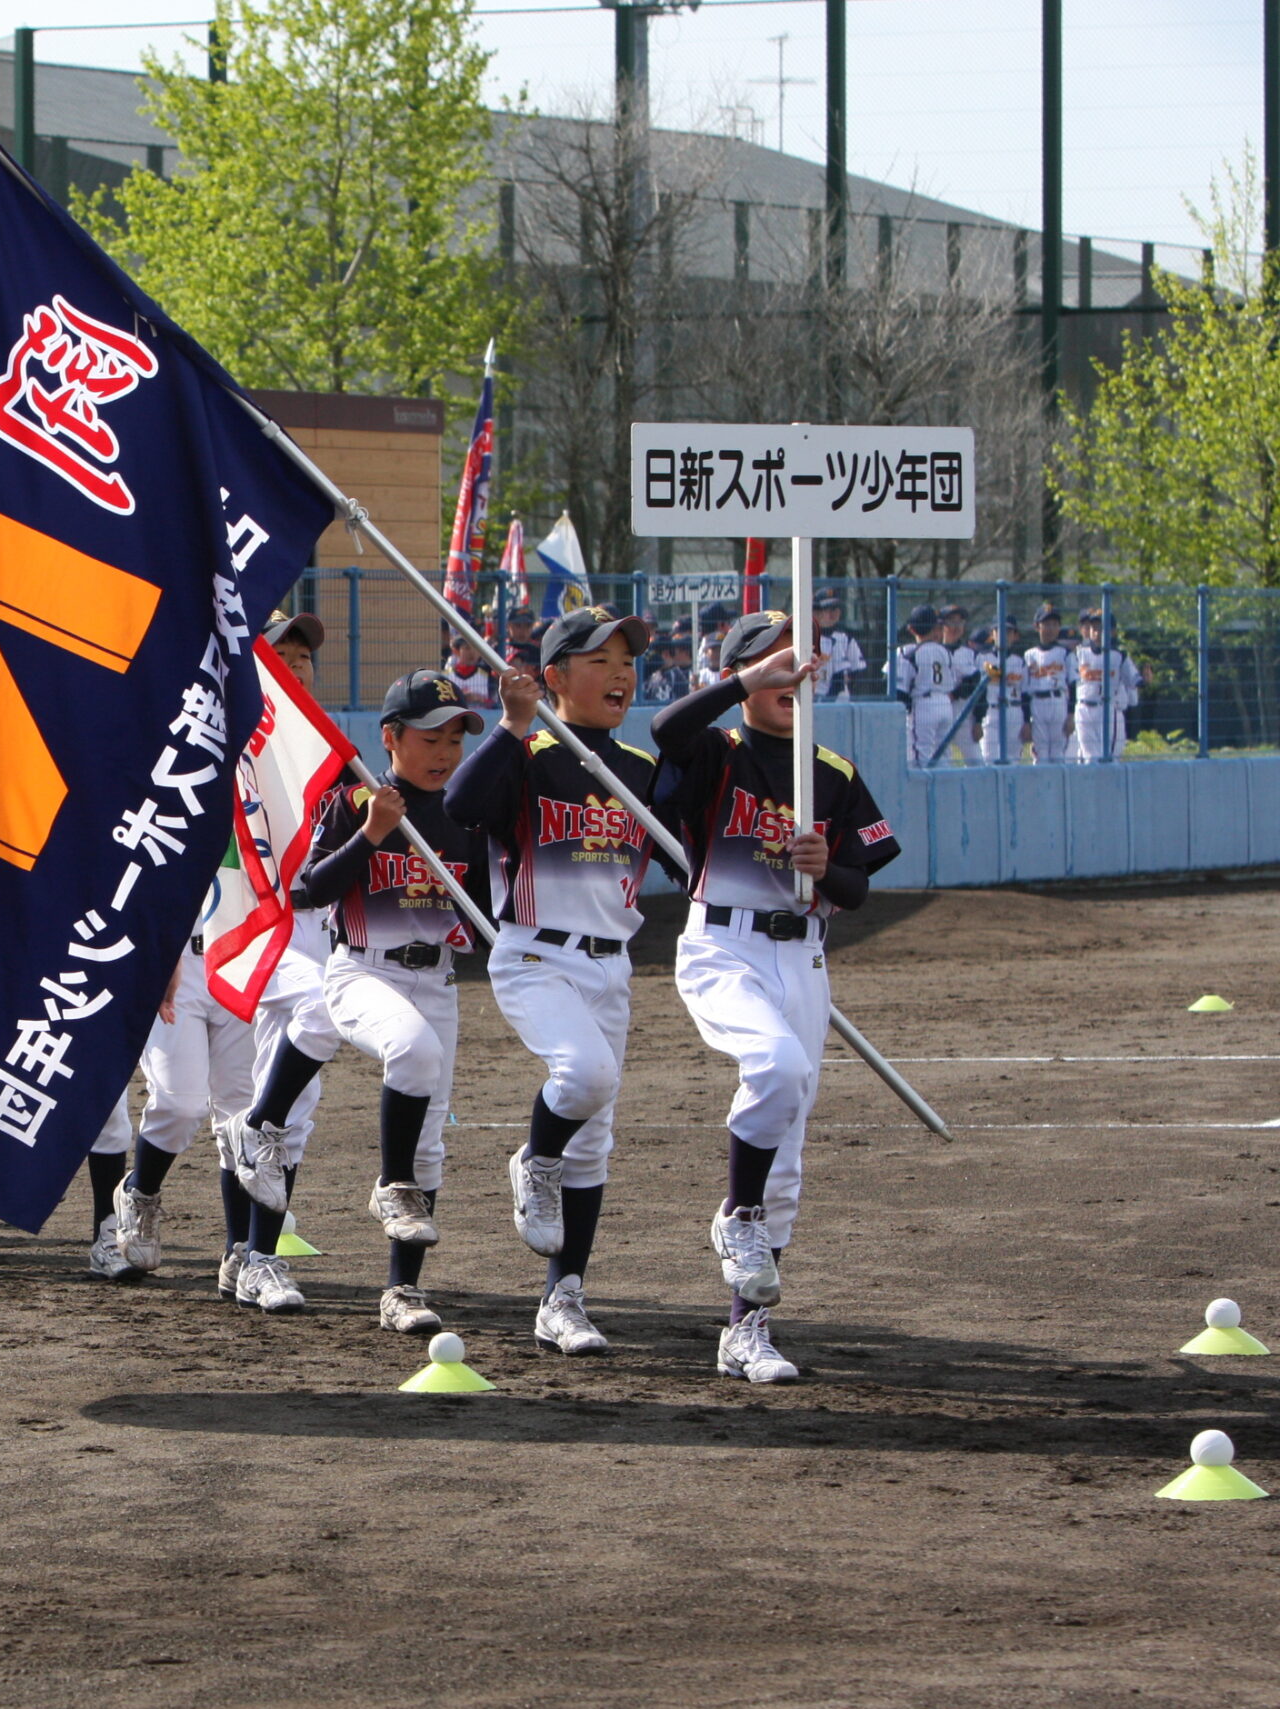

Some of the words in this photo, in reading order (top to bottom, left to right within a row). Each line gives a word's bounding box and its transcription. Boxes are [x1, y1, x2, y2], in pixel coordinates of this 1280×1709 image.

[646, 447, 962, 513] 日新スポーツ少年団
[932, 660, 942, 685] 8
[571, 851, 610, 862] SPORTS
